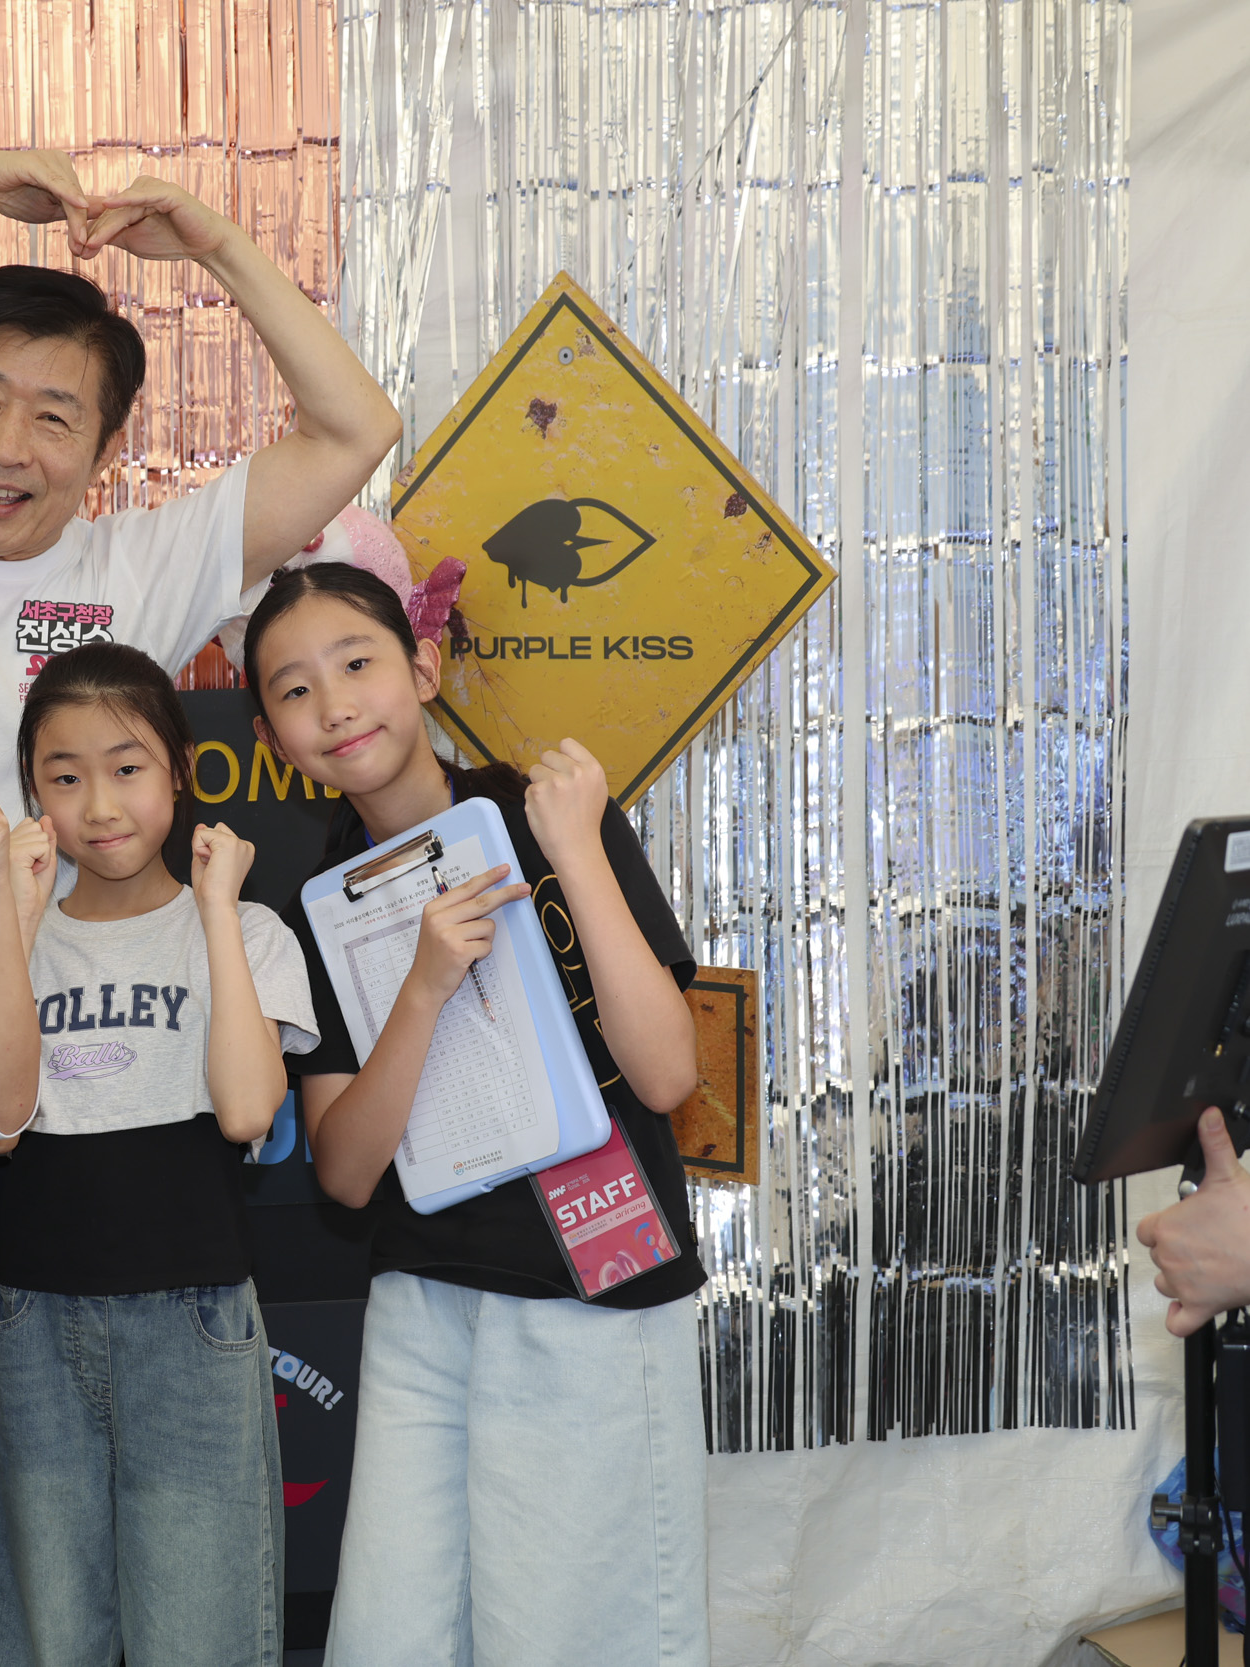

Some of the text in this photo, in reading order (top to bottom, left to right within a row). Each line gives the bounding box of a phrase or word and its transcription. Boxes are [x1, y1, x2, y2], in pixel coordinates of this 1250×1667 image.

[21, 601, 112, 625] 서초구청장
[450, 636, 694, 660] PURPLE K!SS
[36, 983, 190, 1035] OLLEY
[556, 1172, 636, 1229] STAFF
[615, 1201, 646, 1220] arirang
